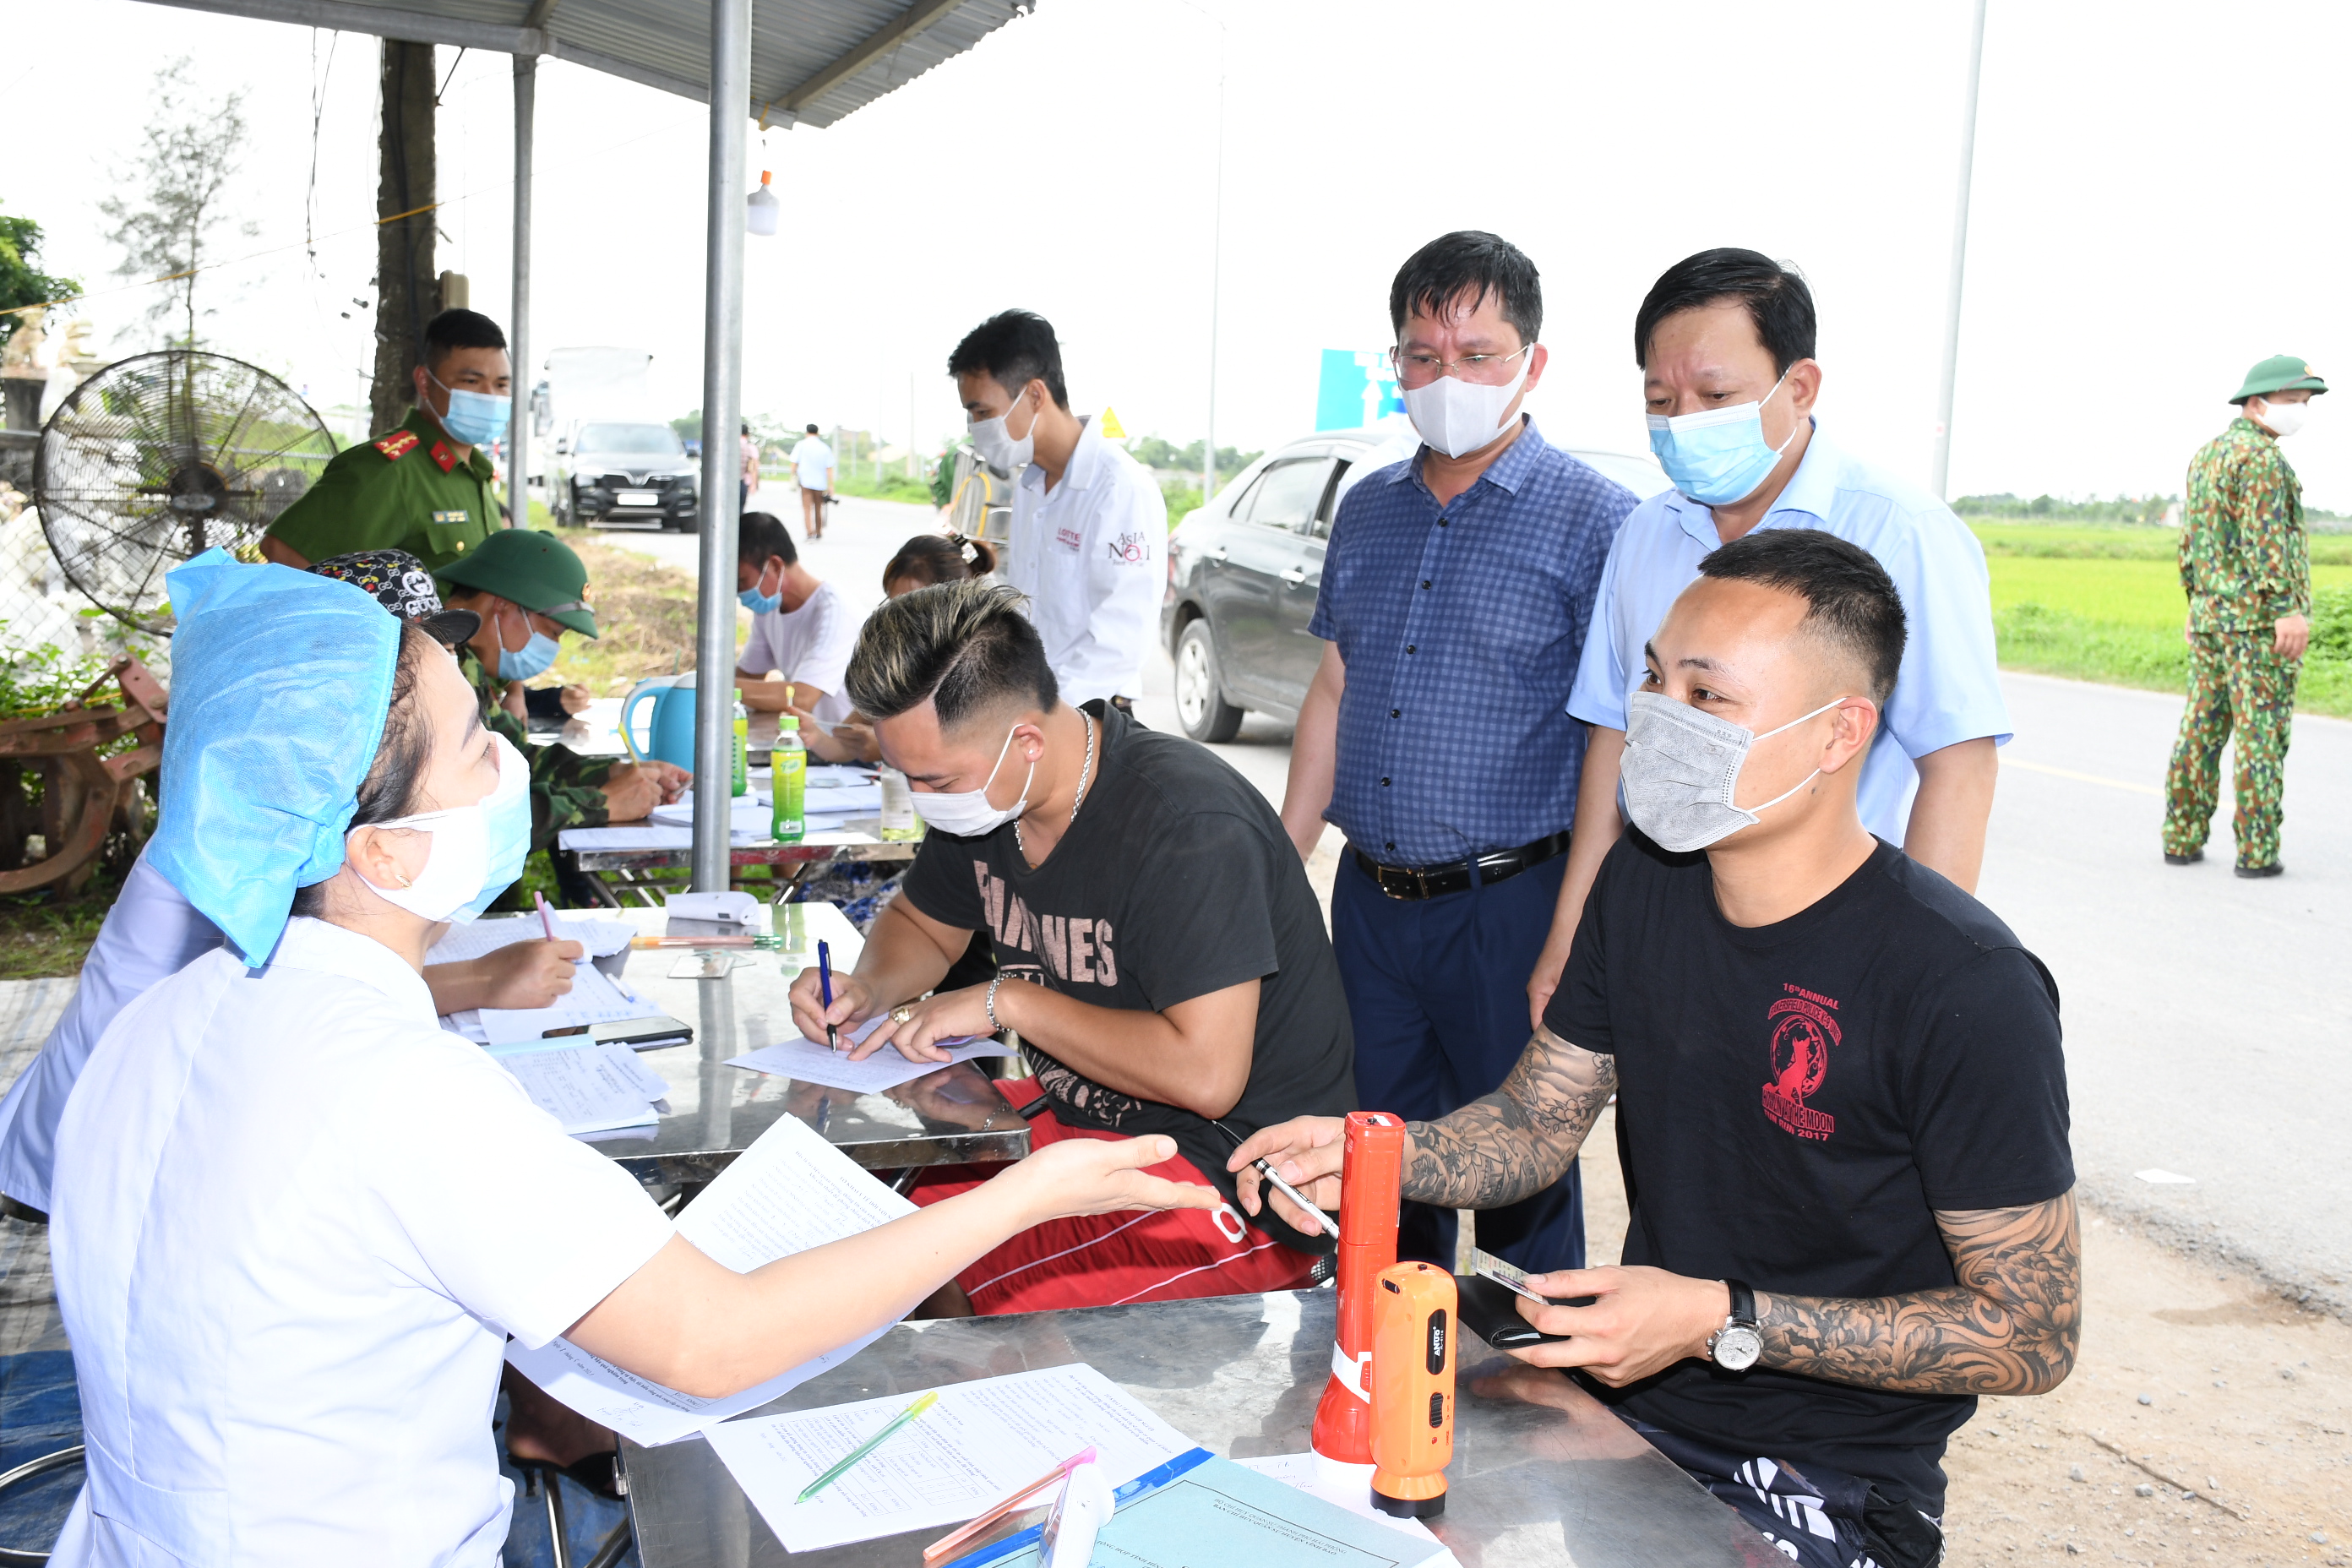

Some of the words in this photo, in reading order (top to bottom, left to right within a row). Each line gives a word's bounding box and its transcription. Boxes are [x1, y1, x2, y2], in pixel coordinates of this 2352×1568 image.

[1117, 531, 1146, 546] ASIA
[1798, 988, 1839, 1010] ANNUAL
[1778, 1119, 1795, 1135] RUN
[1797, 1129, 1829, 1141] 2017
[1805, 1108, 1834, 1133] MOON
